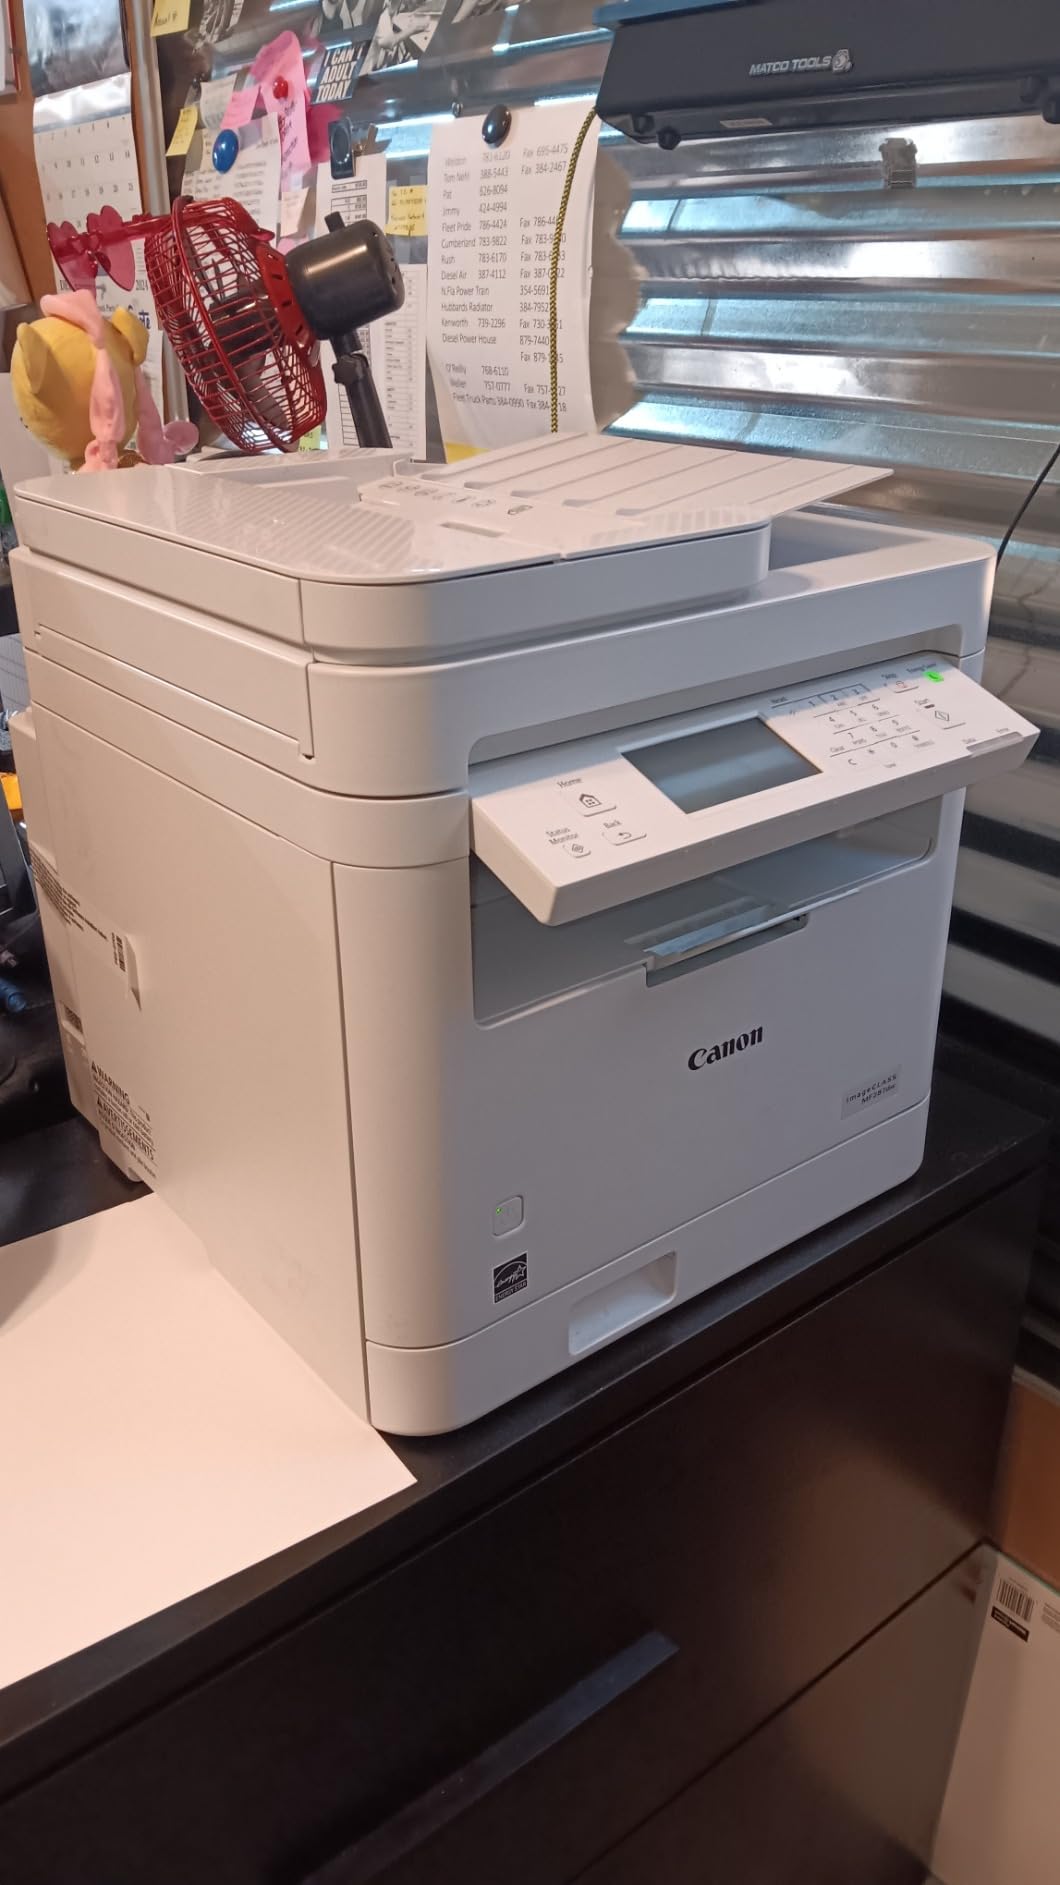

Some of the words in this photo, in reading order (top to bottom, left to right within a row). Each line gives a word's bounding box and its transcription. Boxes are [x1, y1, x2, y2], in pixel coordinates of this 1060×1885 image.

[324, 51, 330, 67] I
[320, 61, 358, 84] ADULT
[749, 60, 789, 76] MATCO
[792, 56, 832, 72] TOOLS
[316, 80, 352, 103] TODAY
[523, 148, 534, 158] Fax
[521, 165, 532, 175] Fax
[443, 190, 452, 200] Pat
[442, 223, 456, 232] Fleet
[456, 222, 472, 231] Pride
[520, 217, 530, 227] Fax
[534, 216, 560, 227] 786-44
[441, 238, 476, 249] Cumberland
[479, 236, 507, 247] 783-9822
[521, 234, 531, 245] Fax
[536, 233, 567, 244] 783-90
[441, 255, 455, 264] Rush
[479, 252, 507, 263] 783-6170
[521, 251, 531, 261] Fax
[441, 271, 458, 280] Diesel
[459, 271, 467, 279] Air
[478, 269, 507, 279] 387-4112
[520, 268, 531, 278] Fax
[456, 287, 474, 296] Power
[476, 286, 489, 296] Train
[520, 285, 549, 296] 354-5691
[441, 303, 468, 312] Hubbards
[469, 303, 493, 312] Radiator
[520, 302, 549, 312] 384-7952
[441, 318, 468, 328] Kenworth
[478, 318, 506, 328] 739-2296
[520, 319, 530, 329] Fax
[442, 333, 459, 343] Diesel
[460, 333, 477, 343] Power
[478, 335, 497, 344] House
[520, 335, 549, 346] 879-7440
[521, 351, 531, 361] Fax
[523, 384, 534, 394] Fax
[536, 384, 566, 396] 757-27
[452, 392, 465, 402] Fleet
[465, 393, 481, 404] Truck
[481, 395, 496, 406] Parts
[526, 399, 536, 409] Fax
[538, 400, 567, 412] 384-18
[557, 778, 582, 788] Home
[688, 1026, 763, 1071] Canon
[97, 1065, 130, 1105] WARNING
[494, 1287, 514, 1302] ENERGY
[514, 1280, 528, 1294] STAR
